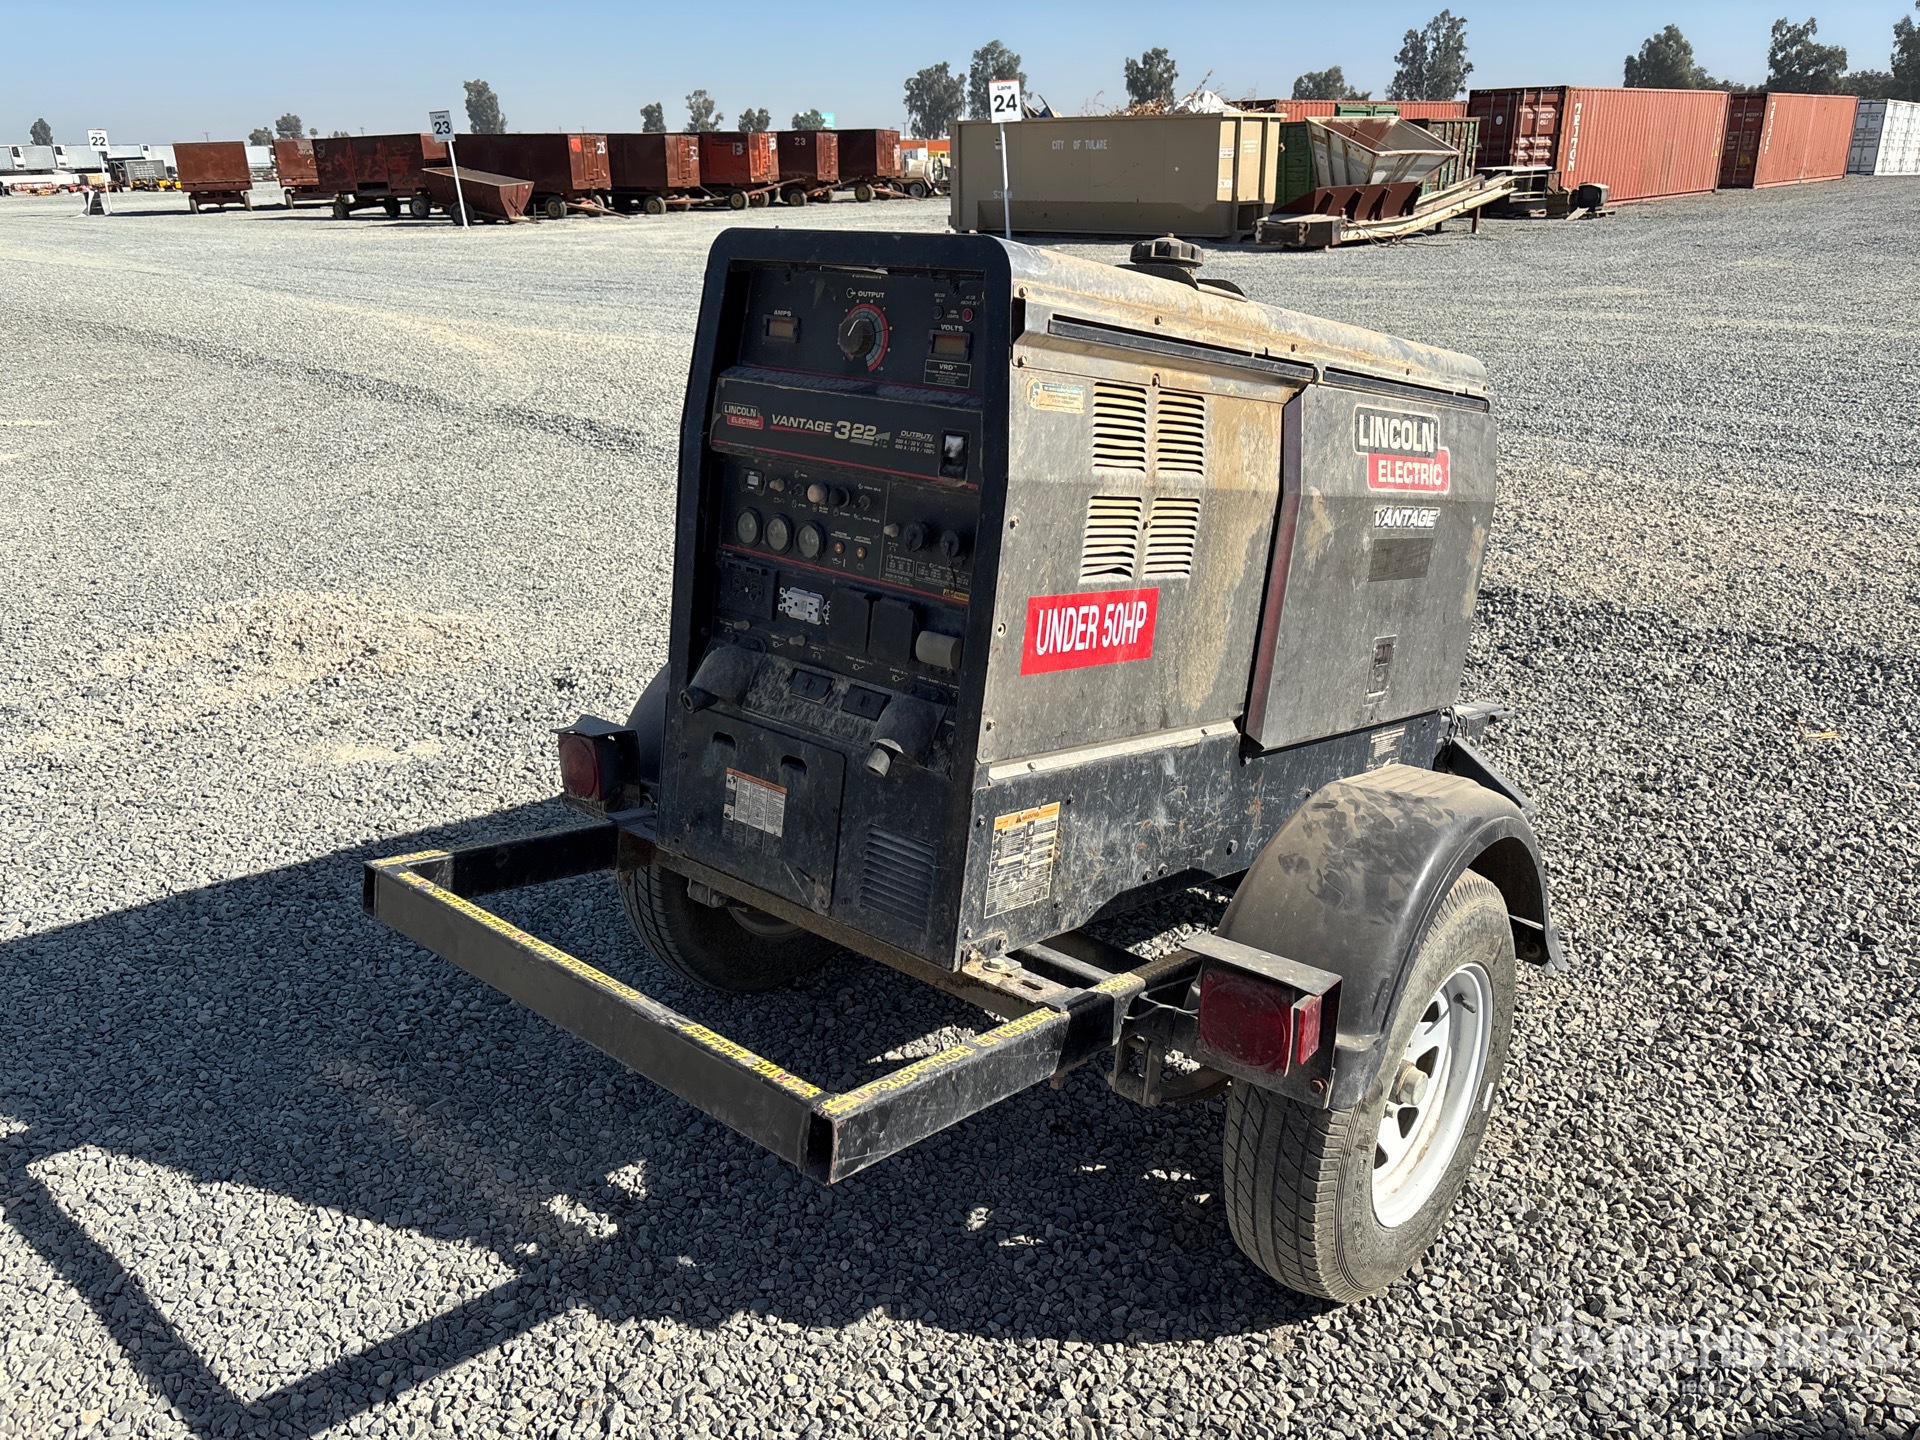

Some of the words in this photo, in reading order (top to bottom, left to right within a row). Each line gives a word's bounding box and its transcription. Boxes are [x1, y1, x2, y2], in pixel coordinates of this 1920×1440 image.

[993, 93, 1018, 113] 24
[434, 120, 451, 135] 23
[91, 136, 107, 146] 22
[793, 136, 807, 147] 23
[1051, 139, 1065, 151] CITY
[1072, 139, 1082, 151] OF
[1084, 138, 1108, 151] TULARE
[857, 290, 885, 300] OUTPUT
[773, 309, 792, 318] AMPS
[940, 323, 964, 333] VOLTS
[724, 403, 758, 419] LINCOLN
[730, 415, 761, 428] ELECTRIC
[771, 413, 834, 434] VANTAGE
[834, 419, 878, 441] 322
[1358, 413, 1435, 453] LINCOLN
[1377, 458, 1443, 486] ELECTRIC
[1374, 507, 1438, 528] VANTAGE
[1035, 604, 1101, 656] UNDER
[1101, 600, 1148, 648] 50HP
[459, 903, 492, 923] STAND
[488, 918, 519, 937] HERE
[525, 936, 543, 949] NE
[543, 946, 563, 960] PAS
[563, 956, 599, 978] TENEZ
[1002, 1025, 1020, 1036] NE
[1020, 1015, 1043, 1029] PAS
[691, 1025, 709, 1039] SE
[708, 1035, 743, 1057] PARE
[867, 1082, 893, 1096] DO
[893, 1068, 917, 1085] NOT
